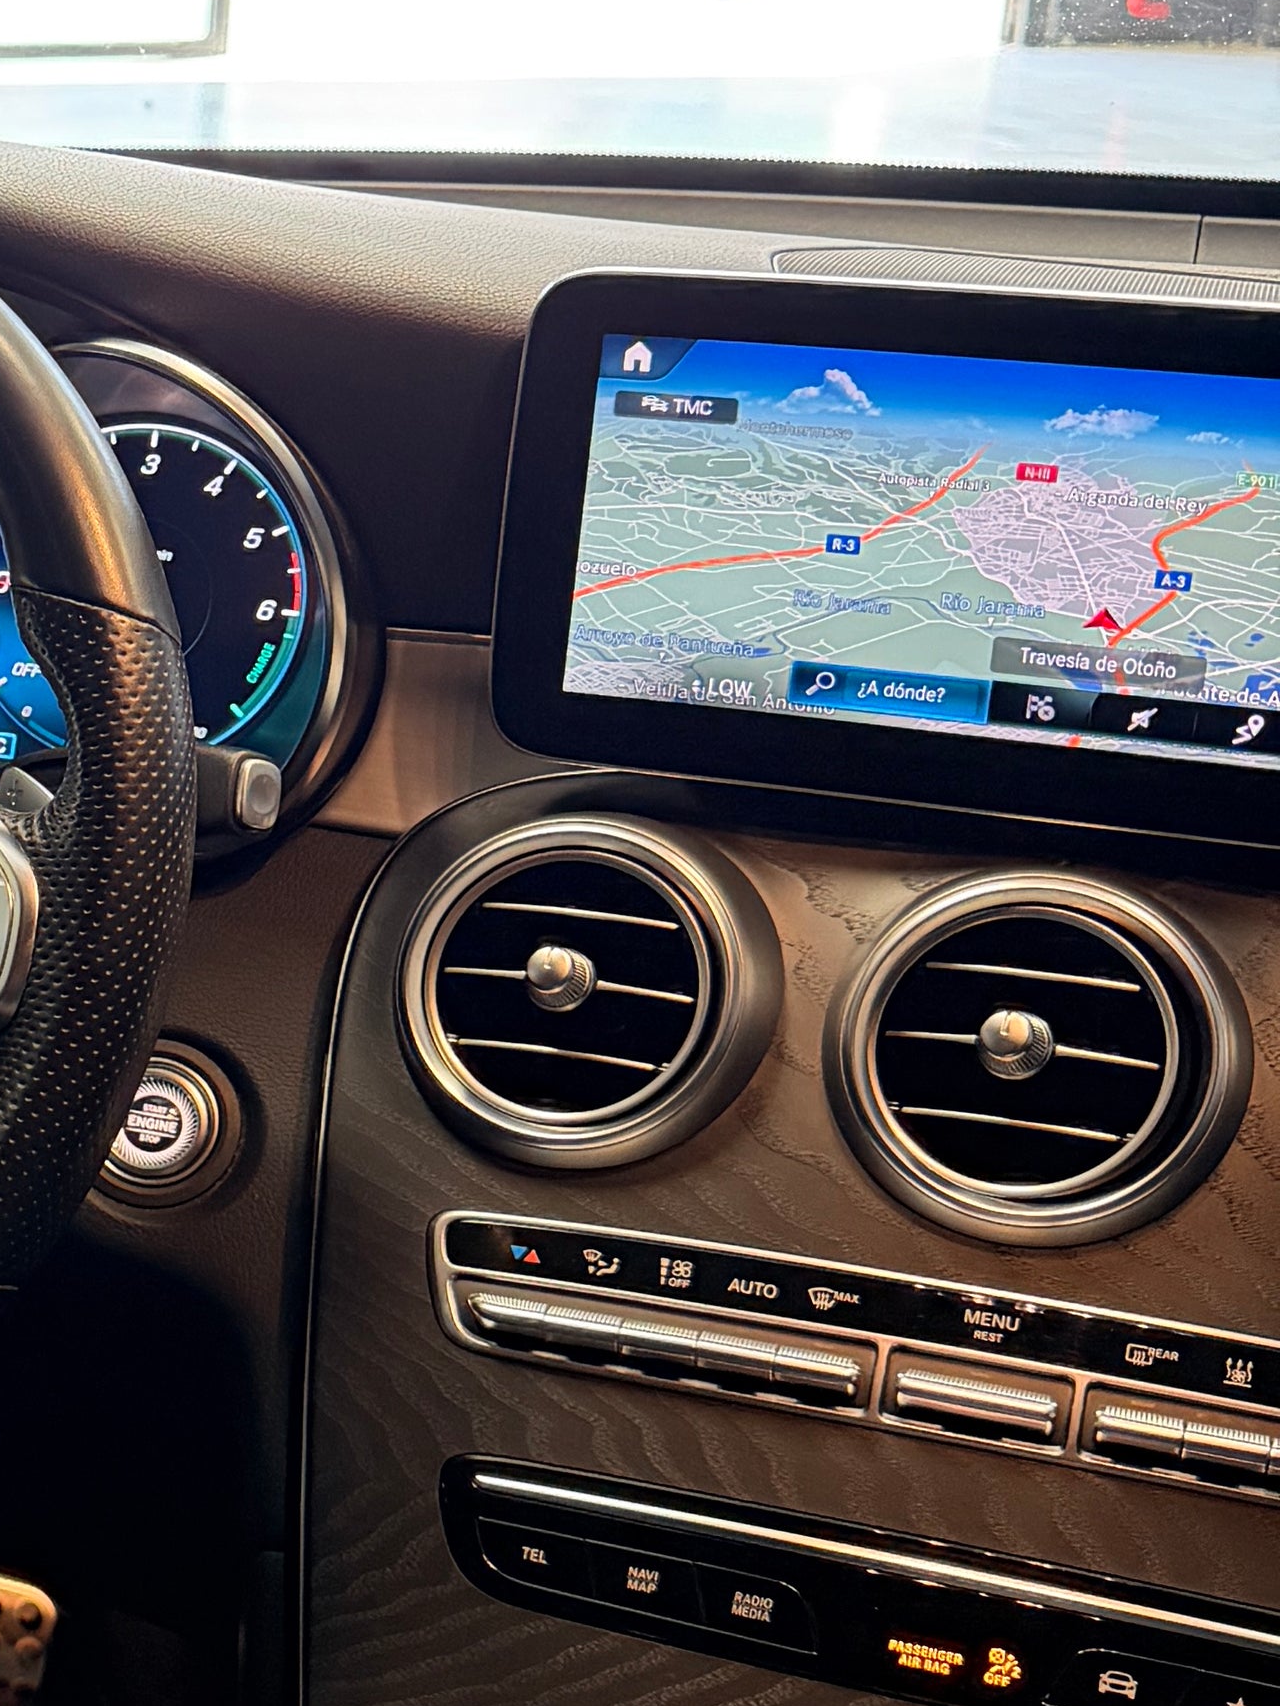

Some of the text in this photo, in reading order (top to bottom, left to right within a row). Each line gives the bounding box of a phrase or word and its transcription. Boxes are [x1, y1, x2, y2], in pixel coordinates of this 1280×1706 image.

[672, 397, 714, 417] TMC
[140, 453, 162, 476] 3
[203, 475, 225, 498] 4
[877, 471, 991, 493] Autopista Radial 3
[1068, 486, 1208, 515] Arganda del Rey
[242, 526, 266, 550] 5
[831, 537, 856, 552] R-3
[1159, 573, 1187, 589] A-3
[255, 599, 278, 622] 6
[941, 593, 1047, 619] Río Jarama
[574, 624, 637, 647] Arroyo
[639, 631, 666, 648] de
[11, 661, 42, 678] OFF
[245, 642, 276, 685] CHARGE
[1020, 646, 1090, 673] Travesía
[1095, 654, 1118, 674] de
[1122, 657, 1177, 681] Otoño
[633, 678, 689, 700] Velilla
[707, 677, 753, 697] LOW
[857, 679, 947, 705] ¿A dónde?
[127, 1114, 180, 1134] ENGINE
[668, 1276, 692, 1290] OFF
[726, 1277, 779, 1300] AUTO
[832, 1292, 861, 1306] MAX
[963, 1308, 1021, 1333] MENU
[973, 1329, 1004, 1344] REST
[1148, 1346, 1180, 1363] REAR
[521, 1545, 549, 1566] TEL
[628, 1566, 660, 1583] NAVI
[626, 1578, 659, 1595] MAP
[734, 1591, 774, 1611] RADIO
[731, 1603, 772, 1624] MEDIA
[887, 1638, 965, 1667] PASSENGER
[897, 1653, 923, 1671] AIR
[982, 1671, 1012, 1688] OFF
